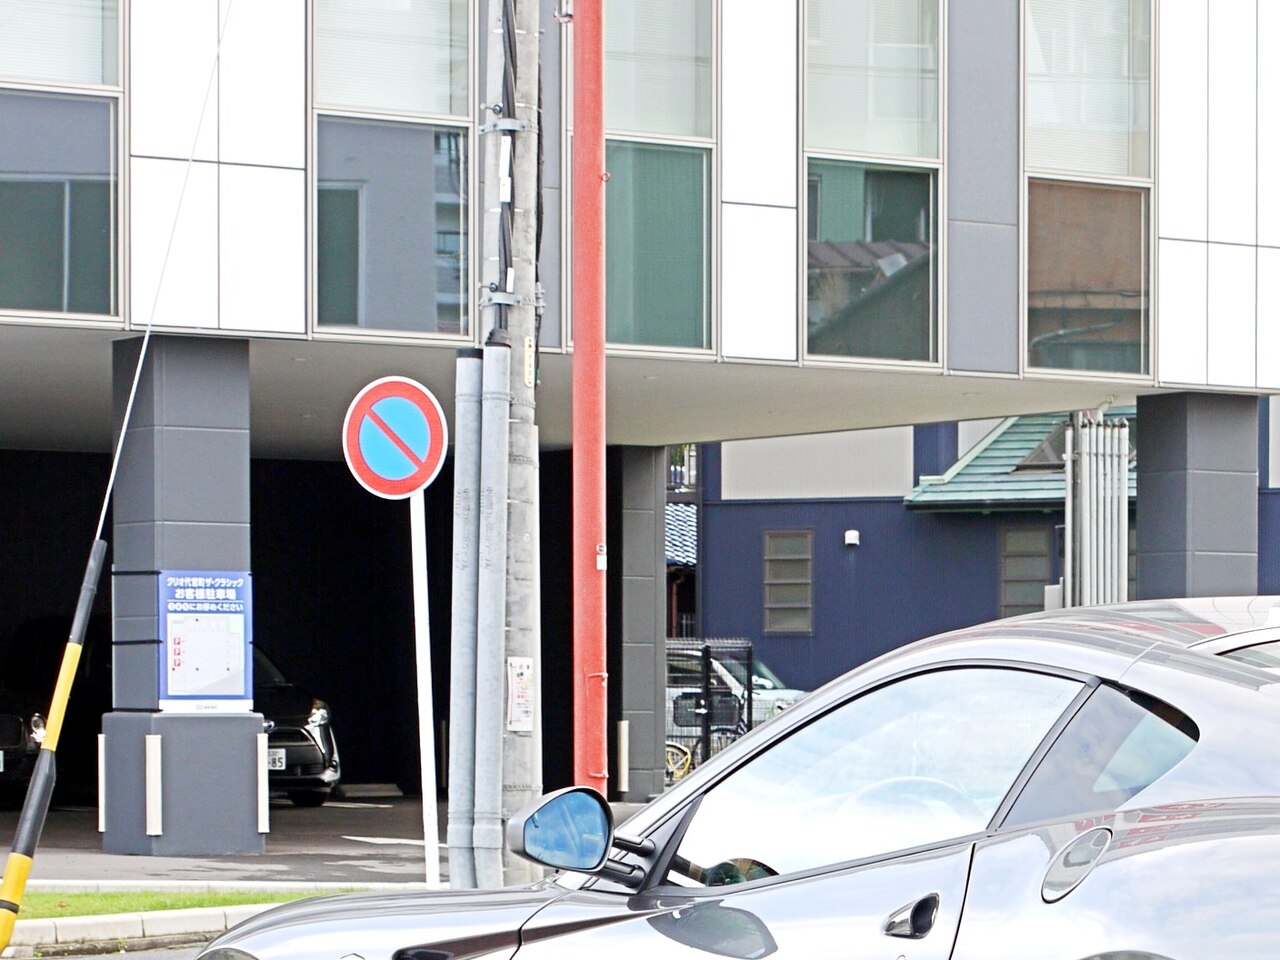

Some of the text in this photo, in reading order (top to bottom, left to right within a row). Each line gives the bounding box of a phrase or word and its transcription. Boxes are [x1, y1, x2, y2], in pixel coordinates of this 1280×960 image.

[175, 588, 237, 600] お客様駐車場
